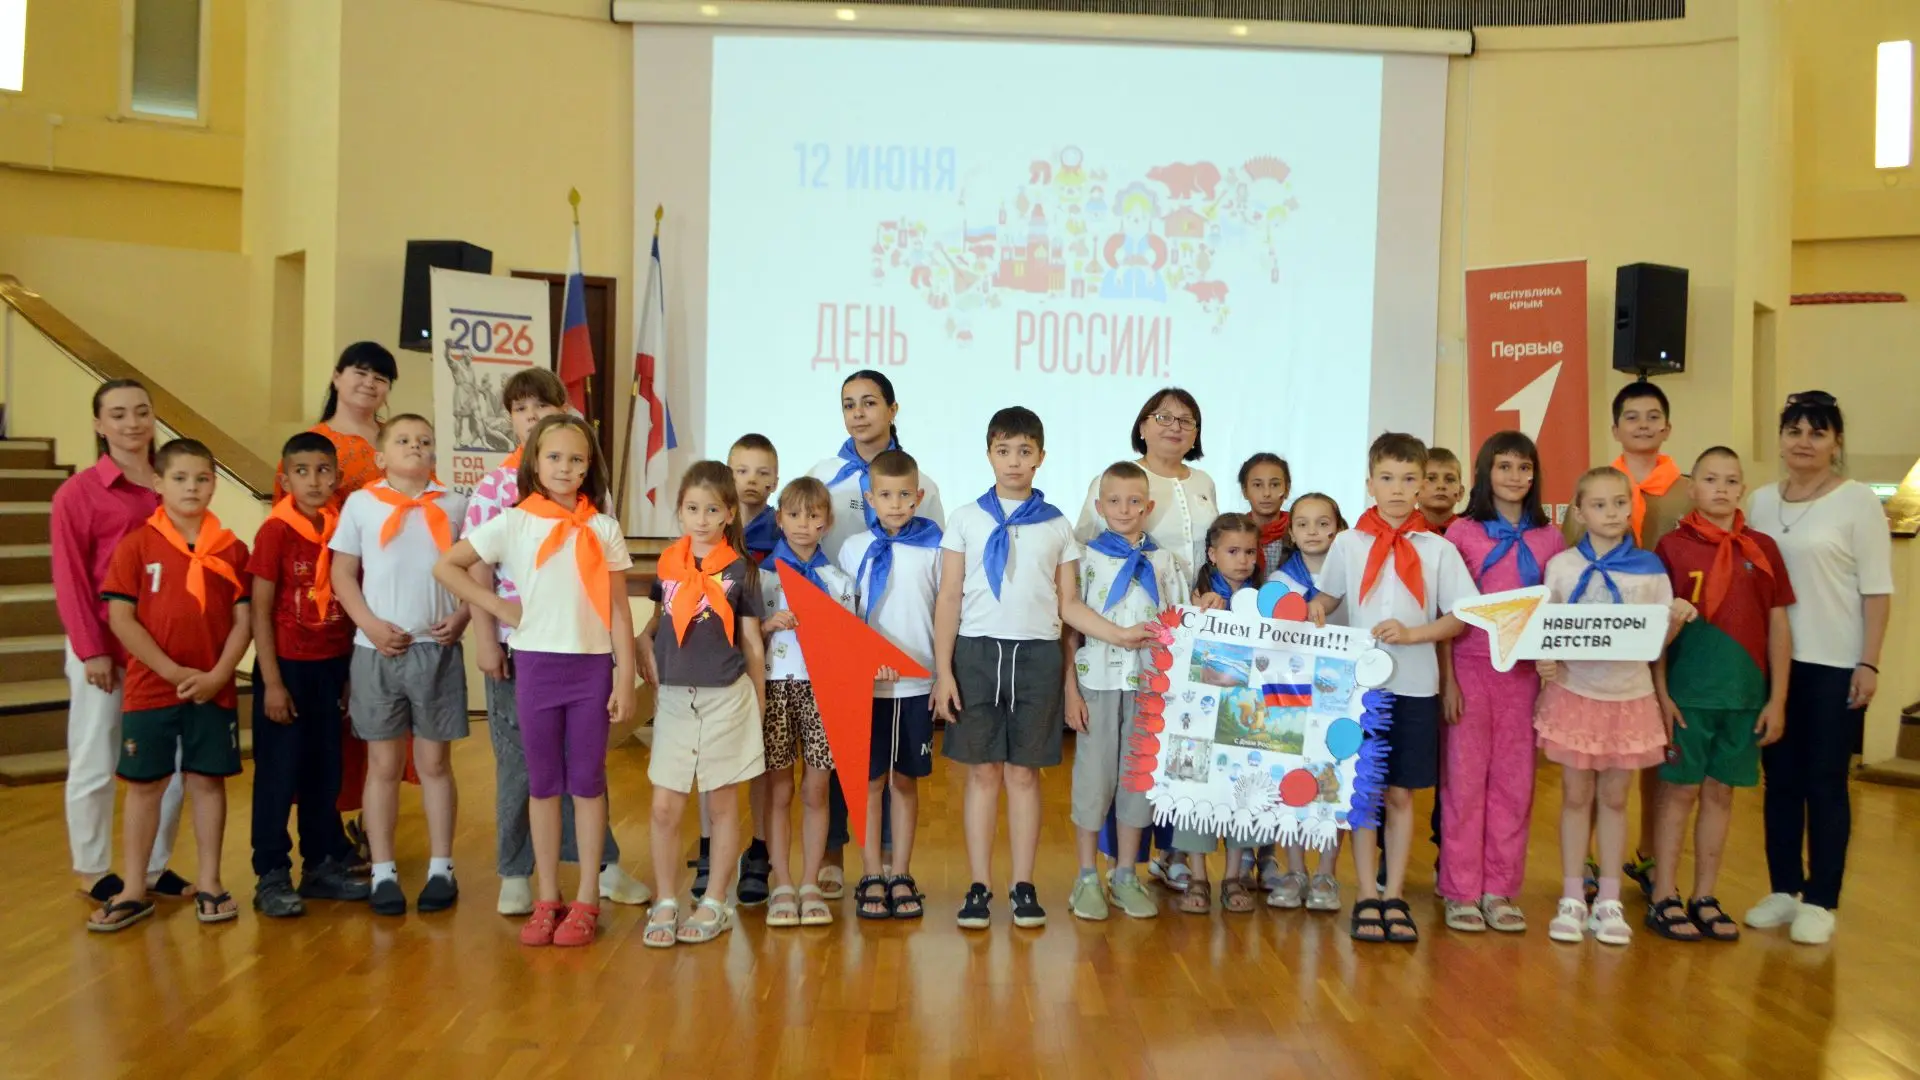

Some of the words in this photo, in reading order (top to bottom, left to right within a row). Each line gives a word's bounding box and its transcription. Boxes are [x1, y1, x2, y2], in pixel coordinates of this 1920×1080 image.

[793, 141, 830, 189] 12
[846, 143, 956, 192] ИЮНЯ
[1489, 286, 1562, 301] РЕСПУБЛИКА
[1509, 299, 1543, 311] КРЫМ
[450, 317, 534, 356] 2026
[811, 302, 909, 372] ДЕНЬ
[1014, 309, 1173, 378] РОССИИ!
[1491, 341, 1564, 361] Первые
[453, 456, 485, 471] ГОД
[146, 563, 162, 592] 7
[1688, 571, 1704, 604] 7
[1181, 611, 1196, 629] С
[1199, 614, 1251, 638] Днем
[1258, 622, 1350, 652] России!!!
[1543, 617, 1647, 630] НАВИГАТОРЫ
[1541, 635, 1612, 649] ДЕТСТВА
